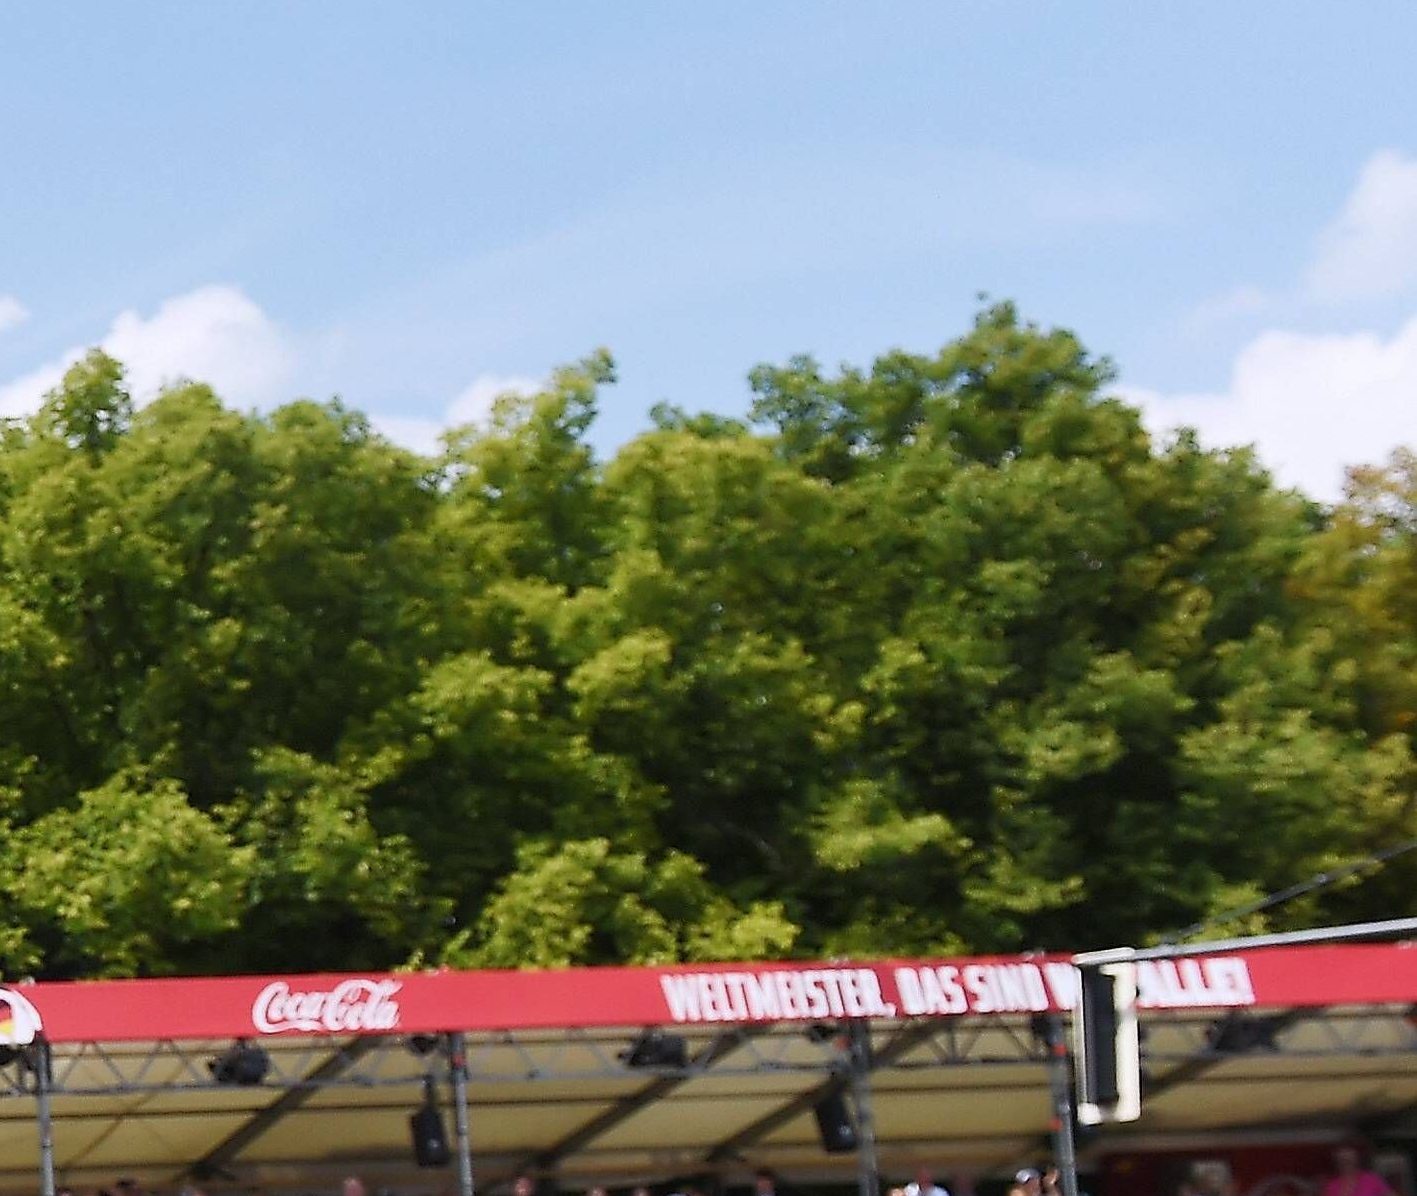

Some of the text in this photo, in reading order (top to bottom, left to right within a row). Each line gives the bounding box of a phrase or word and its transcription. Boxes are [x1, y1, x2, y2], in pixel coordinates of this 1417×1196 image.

[252, 979, 402, 1034] Coca-Cola
[895, 965, 967, 1015] DAS
[963, 961, 1049, 1013] SIND
